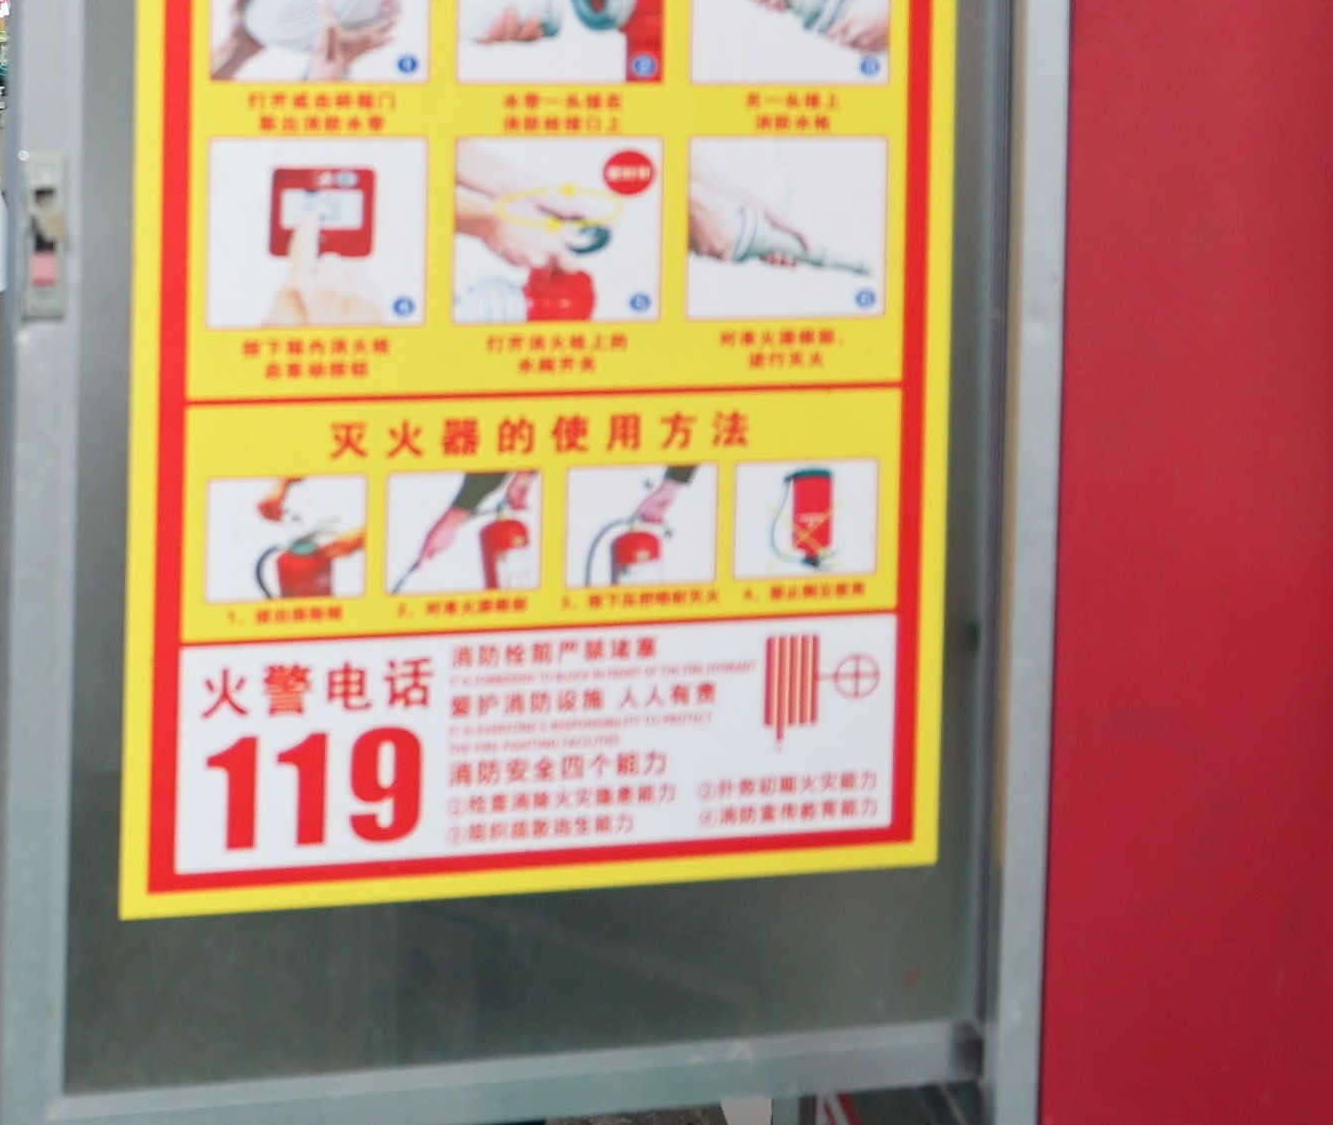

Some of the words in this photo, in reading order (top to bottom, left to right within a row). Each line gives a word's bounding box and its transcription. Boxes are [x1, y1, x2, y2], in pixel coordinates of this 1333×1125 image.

[330, 409, 751, 461] 灭火器的使用方法
[452, 635, 658, 668] 消防栓前严禁堵塞
[201, 659, 434, 719] 火警电话
[451, 687, 604, 718] 爱护消防设施
[618, 682, 716, 710] 人人有责
[206, 726, 424, 851] 119
[450, 752, 666, 787] 消防安全四个能力
